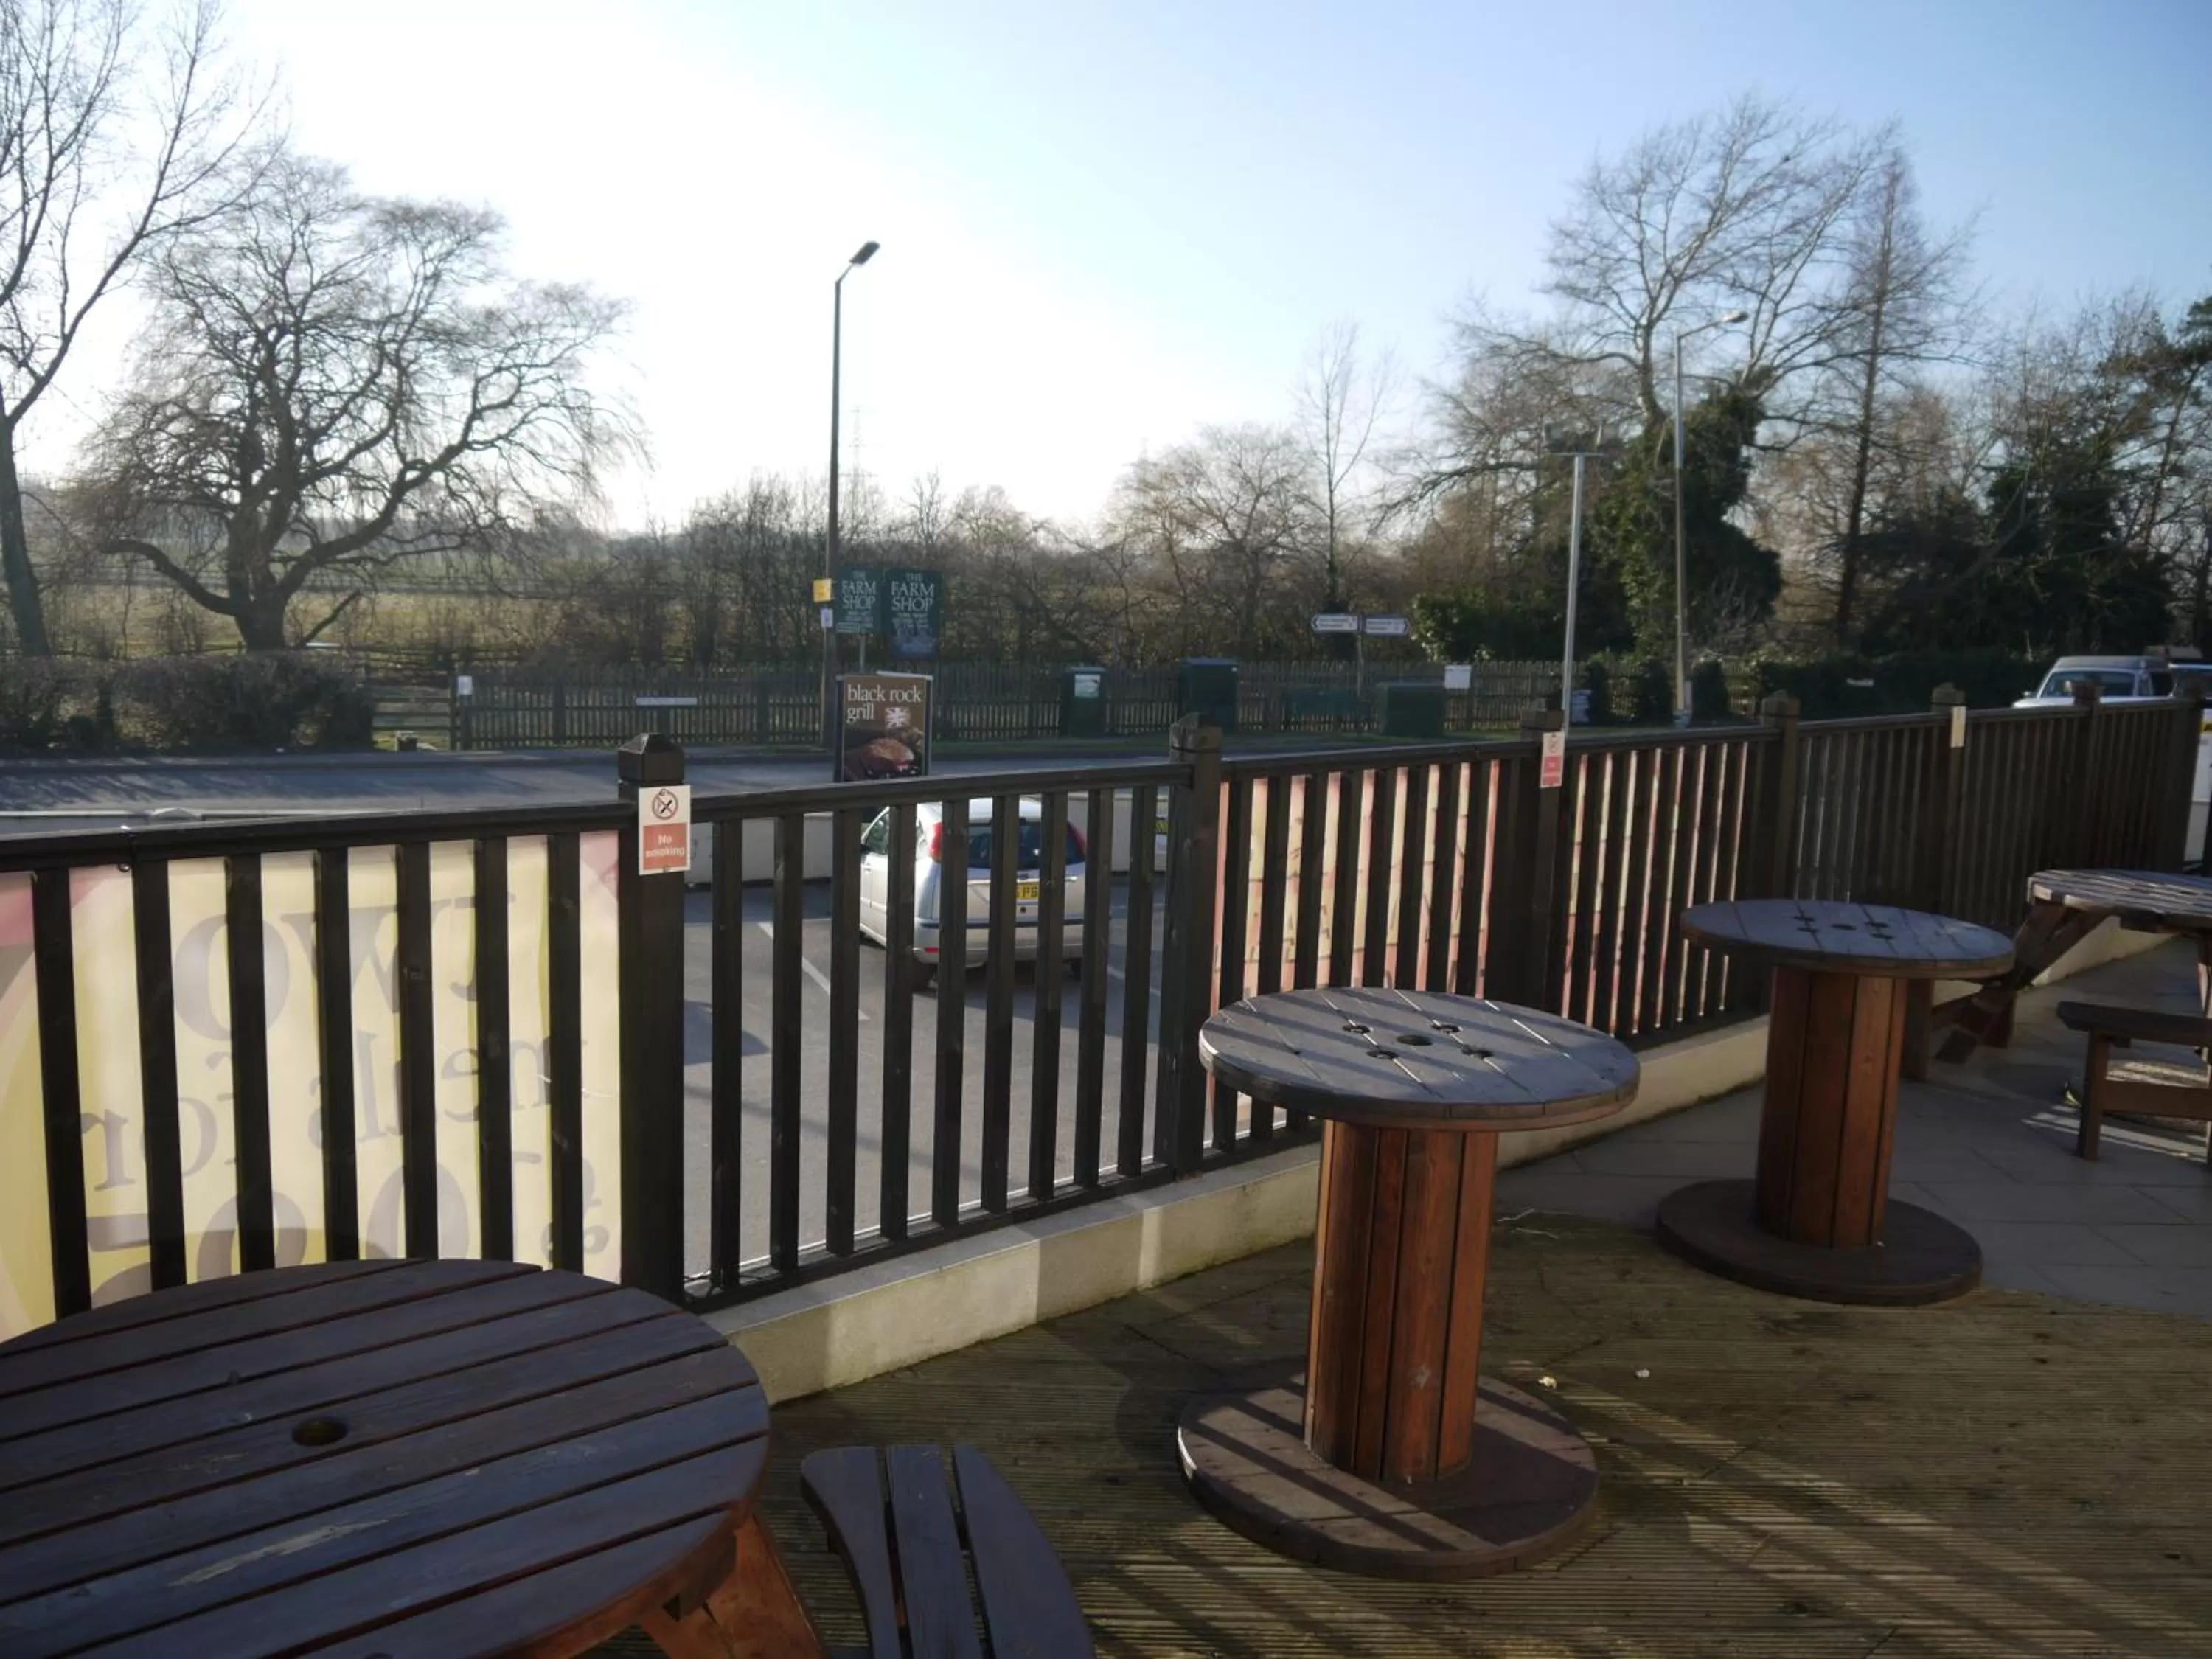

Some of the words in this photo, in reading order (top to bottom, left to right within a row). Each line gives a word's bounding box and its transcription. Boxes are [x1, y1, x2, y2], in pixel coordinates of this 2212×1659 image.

[841, 580, 877, 595] FARM
[891, 581, 935, 597] FARM
[842, 595, 876, 611] SHOP
[891, 597, 934, 611] SHOP
[847, 684, 886, 702] black
[889, 685, 922, 702] rock
[846, 703, 874, 723] grill
[658, 835, 672, 844] No
